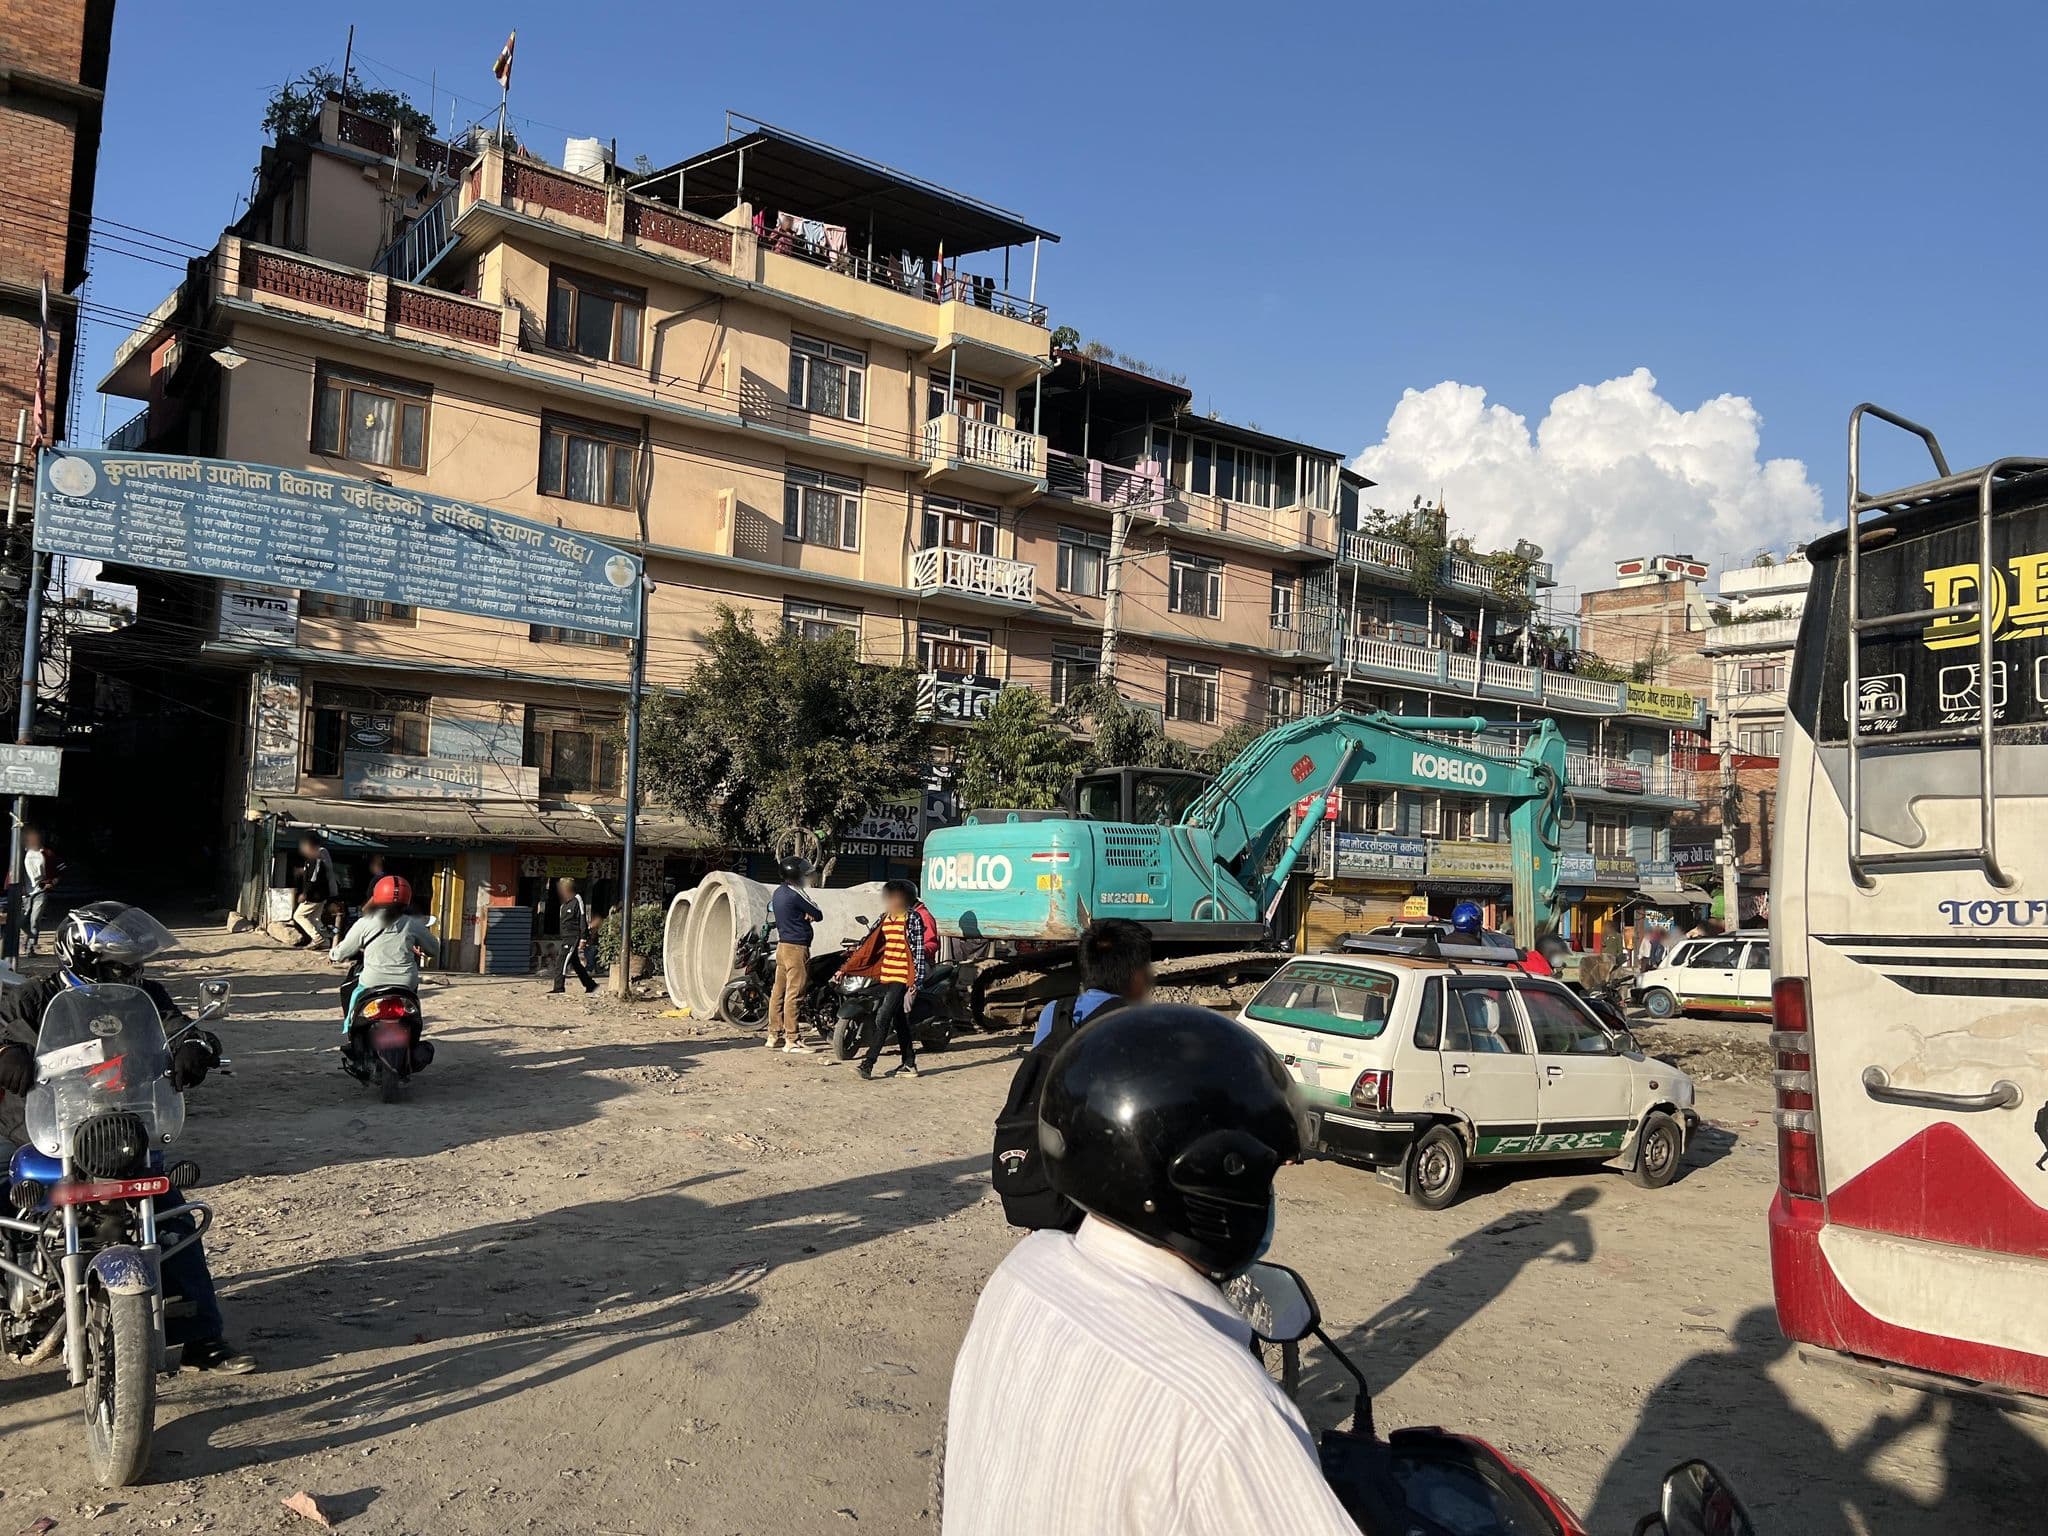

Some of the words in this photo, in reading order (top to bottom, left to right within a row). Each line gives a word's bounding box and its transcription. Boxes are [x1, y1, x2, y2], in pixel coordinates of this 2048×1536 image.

[278, 470, 334, 500] विकास
[431, 503, 488, 530] हार्दिक
[490, 518, 545, 547] स्वागत
[1659, 692, 1675, 708] हाउस
[1411, 751, 1488, 788] KOBELCO
[869, 803, 919, 821] SHOP
[840, 842, 878, 856] FIXED
[881, 844, 914, 858] HERE
[927, 853, 1013, 891] KOBELCO
[1938, 899, 2048, 927] TOU
[1290, 968, 1388, 988] SPORTS
[1489, 1131, 1613, 1154] FIRE
